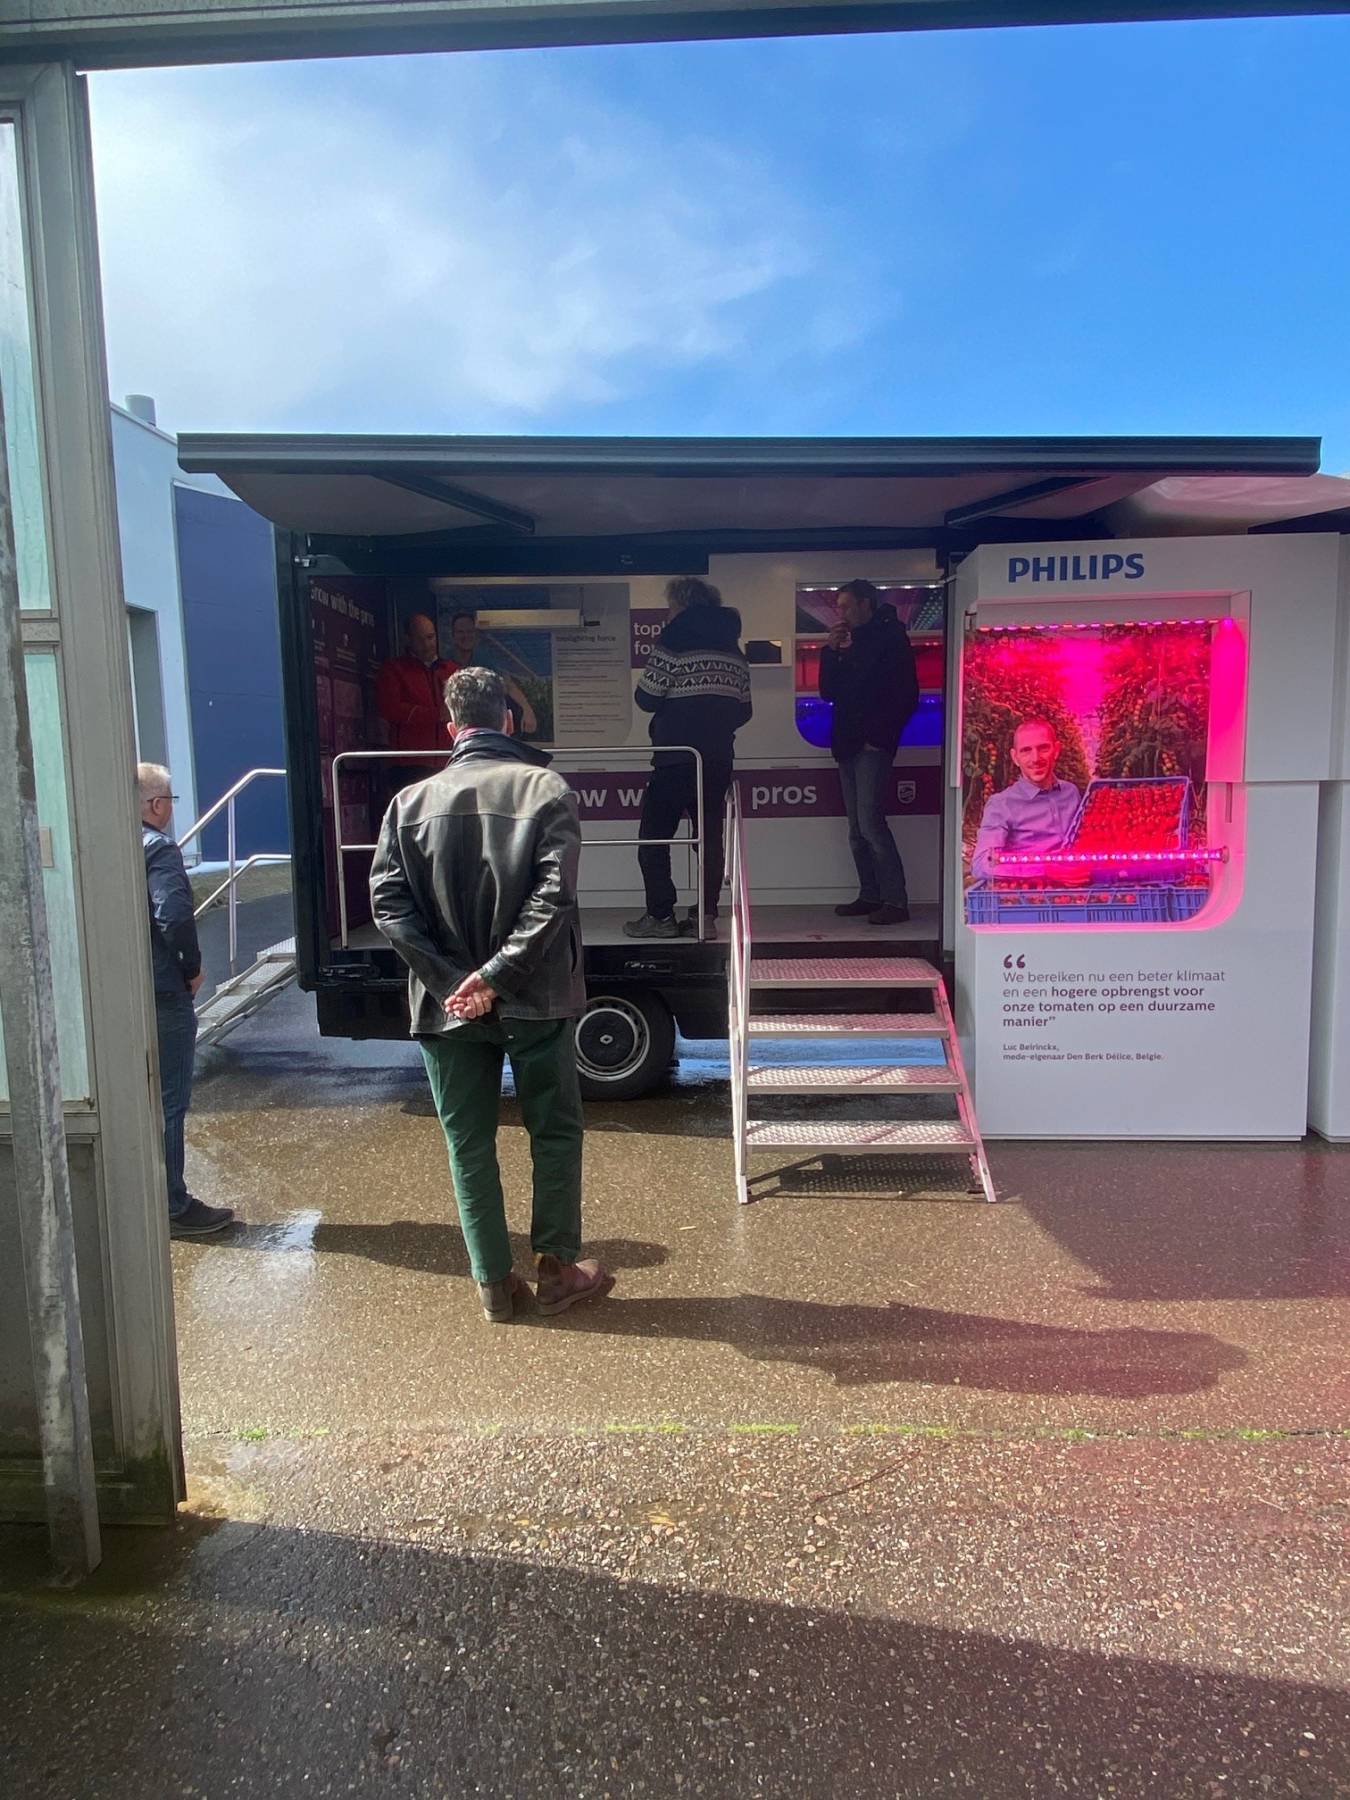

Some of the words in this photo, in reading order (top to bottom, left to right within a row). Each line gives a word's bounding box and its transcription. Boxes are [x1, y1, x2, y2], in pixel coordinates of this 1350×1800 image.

[1008, 552, 1145, 584] PHILIPS
[752, 785, 818, 810] pros
[1003, 972, 1025, 983] We
[1028, 971, 1085, 983] bereiken
[1089, 973, 1106, 982] nu
[1109, 972, 1134, 982] een
[1138, 970, 1174, 982] beter
[1177, 970, 1227, 982] klimaat
[1003, 988, 1020, 998] en
[1023, 988, 1048, 998] een
[1051, 986, 1098, 999] hogere
[1101, 986, 1171, 999] opbrengst
[1174, 987, 1206, 997] voor
[1003, 1003, 1036, 1013] onze
[1039, 1001, 1095, 1013] tomaten
[1098, 1002, 1117, 1015] op
[1120, 1002, 1145, 1012] een
[1148, 1000, 1217, 1014] duurzame
[1003, 1043, 1018, 1052] Luc
[1067, 1053, 1084, 1061] Den
[1085, 1053, 1105, 1061] Berk
